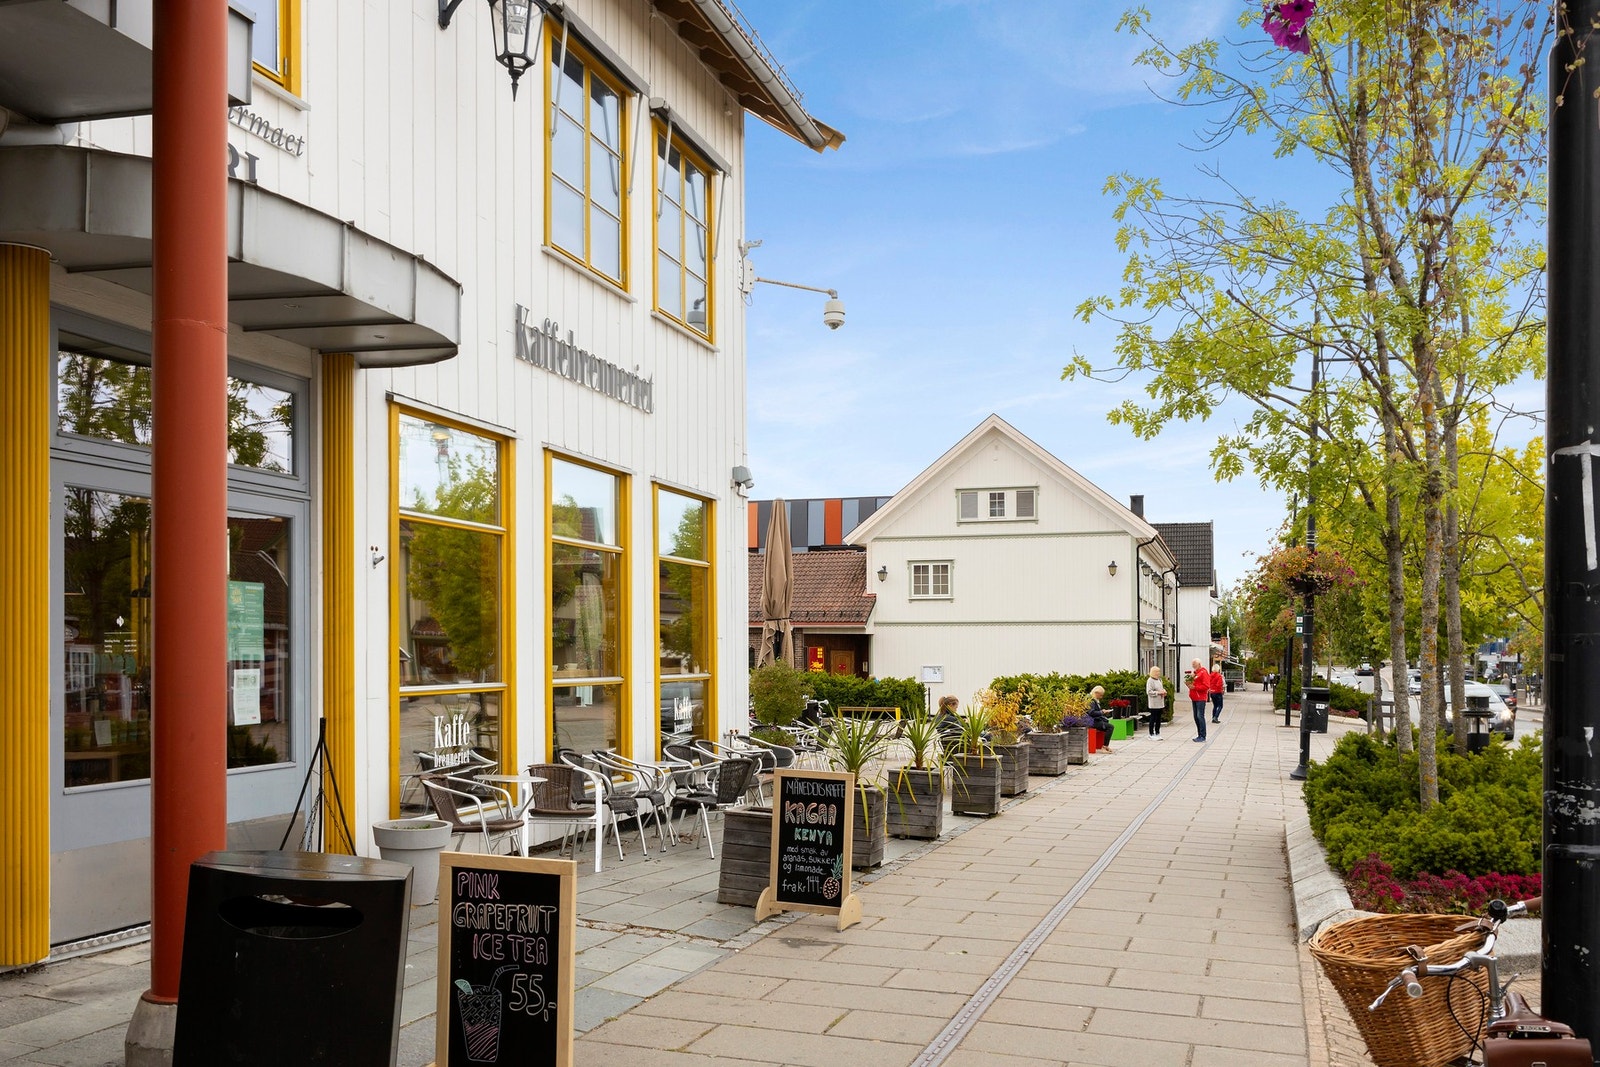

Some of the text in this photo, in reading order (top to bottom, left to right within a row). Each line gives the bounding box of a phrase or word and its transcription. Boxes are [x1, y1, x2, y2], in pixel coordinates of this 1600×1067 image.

[516, 303, 655, 414] Kaffebrenneriet
[434, 713, 470, 748] Kaffe
[787, 845, 829, 857] med smak av
[794, 827, 833, 846] KENYA
[457, 871, 501, 900] PINK
[783, 863, 827, 875] og limonade
[453, 902, 558, 935] GRAPEFRUIT
[472, 933, 548, 966] ICE TEA
[508, 973, 557, 1022] 55,-
